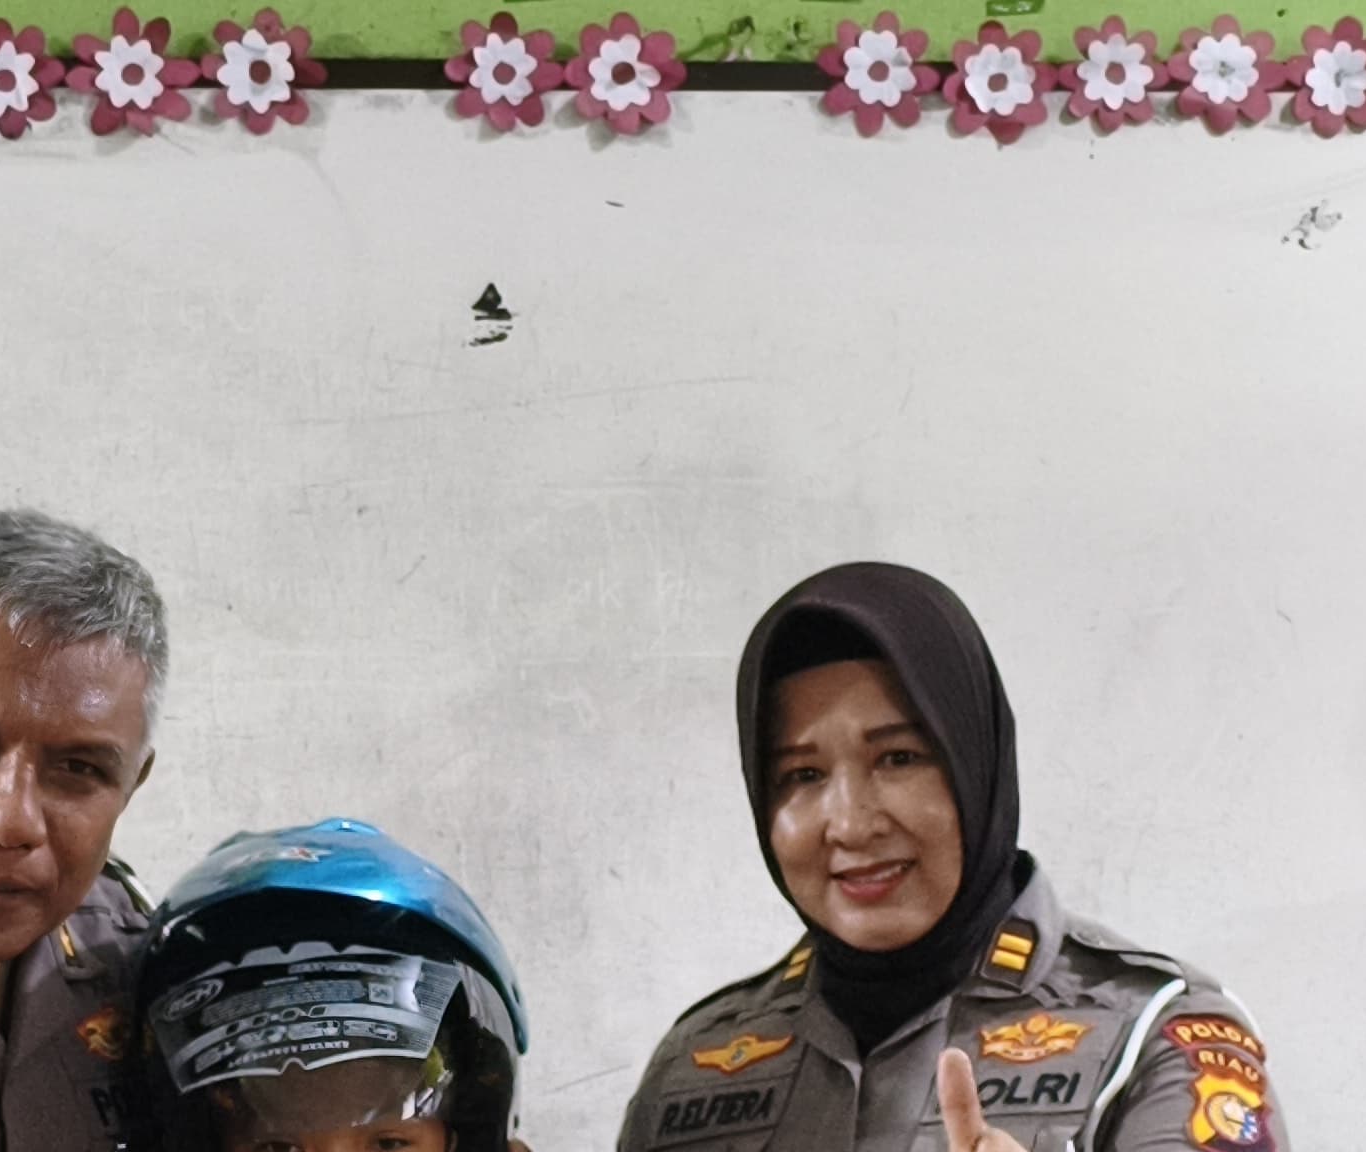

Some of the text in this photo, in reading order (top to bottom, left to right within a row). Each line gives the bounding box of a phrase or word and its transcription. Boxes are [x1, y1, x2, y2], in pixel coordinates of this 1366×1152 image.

[1175, 1022, 1260, 1053] POLDA
[1198, 1050, 1260, 1083] RIAU
[976, 1071, 1082, 1109] OLRI
